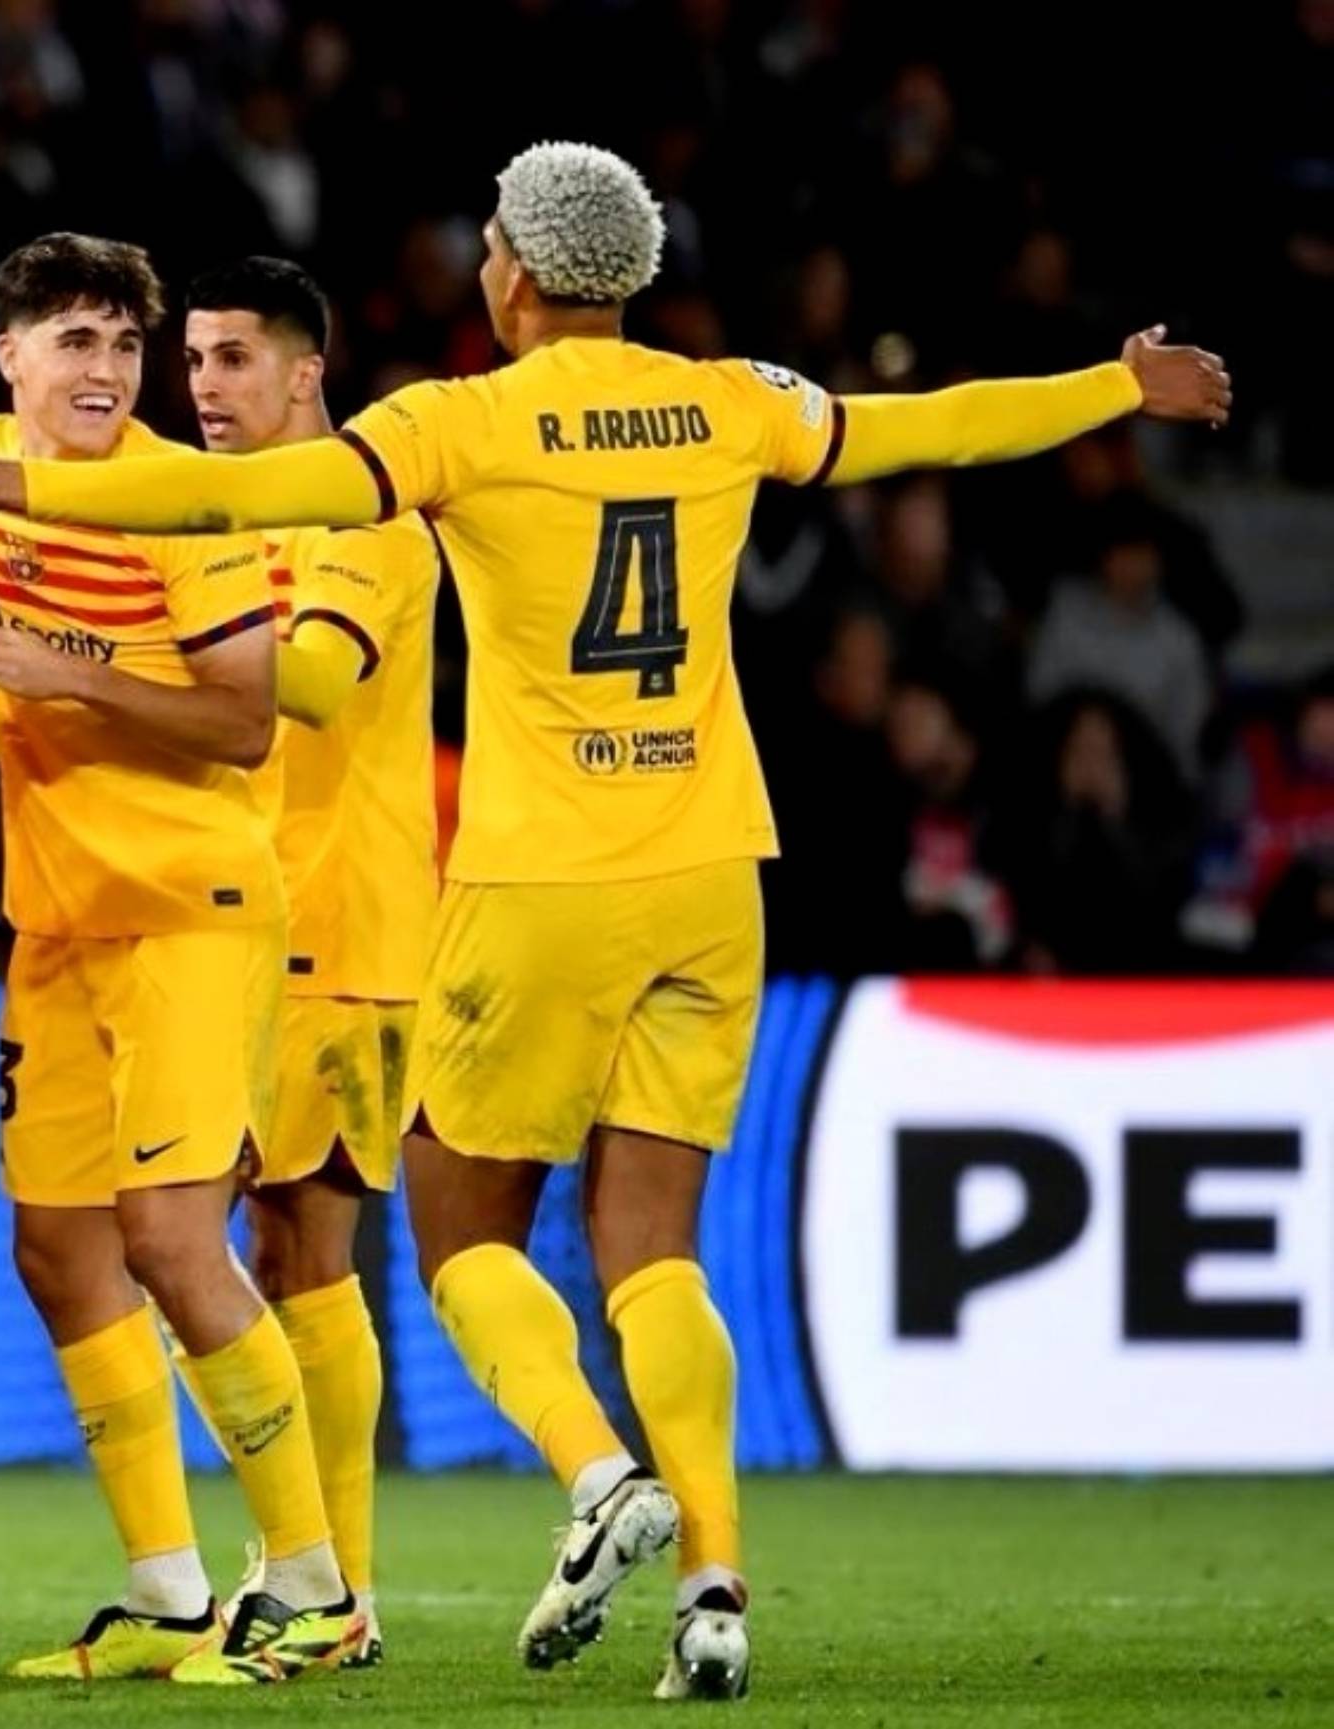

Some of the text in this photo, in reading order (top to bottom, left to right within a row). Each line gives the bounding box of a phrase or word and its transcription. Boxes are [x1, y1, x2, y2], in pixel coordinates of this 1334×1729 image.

[538, 404, 712, 453] R. ARAUJO
[570, 496, 689, 699] 4
[631, 727, 695, 748] UNHCR
[632, 747, 696, 766] ACNUR
